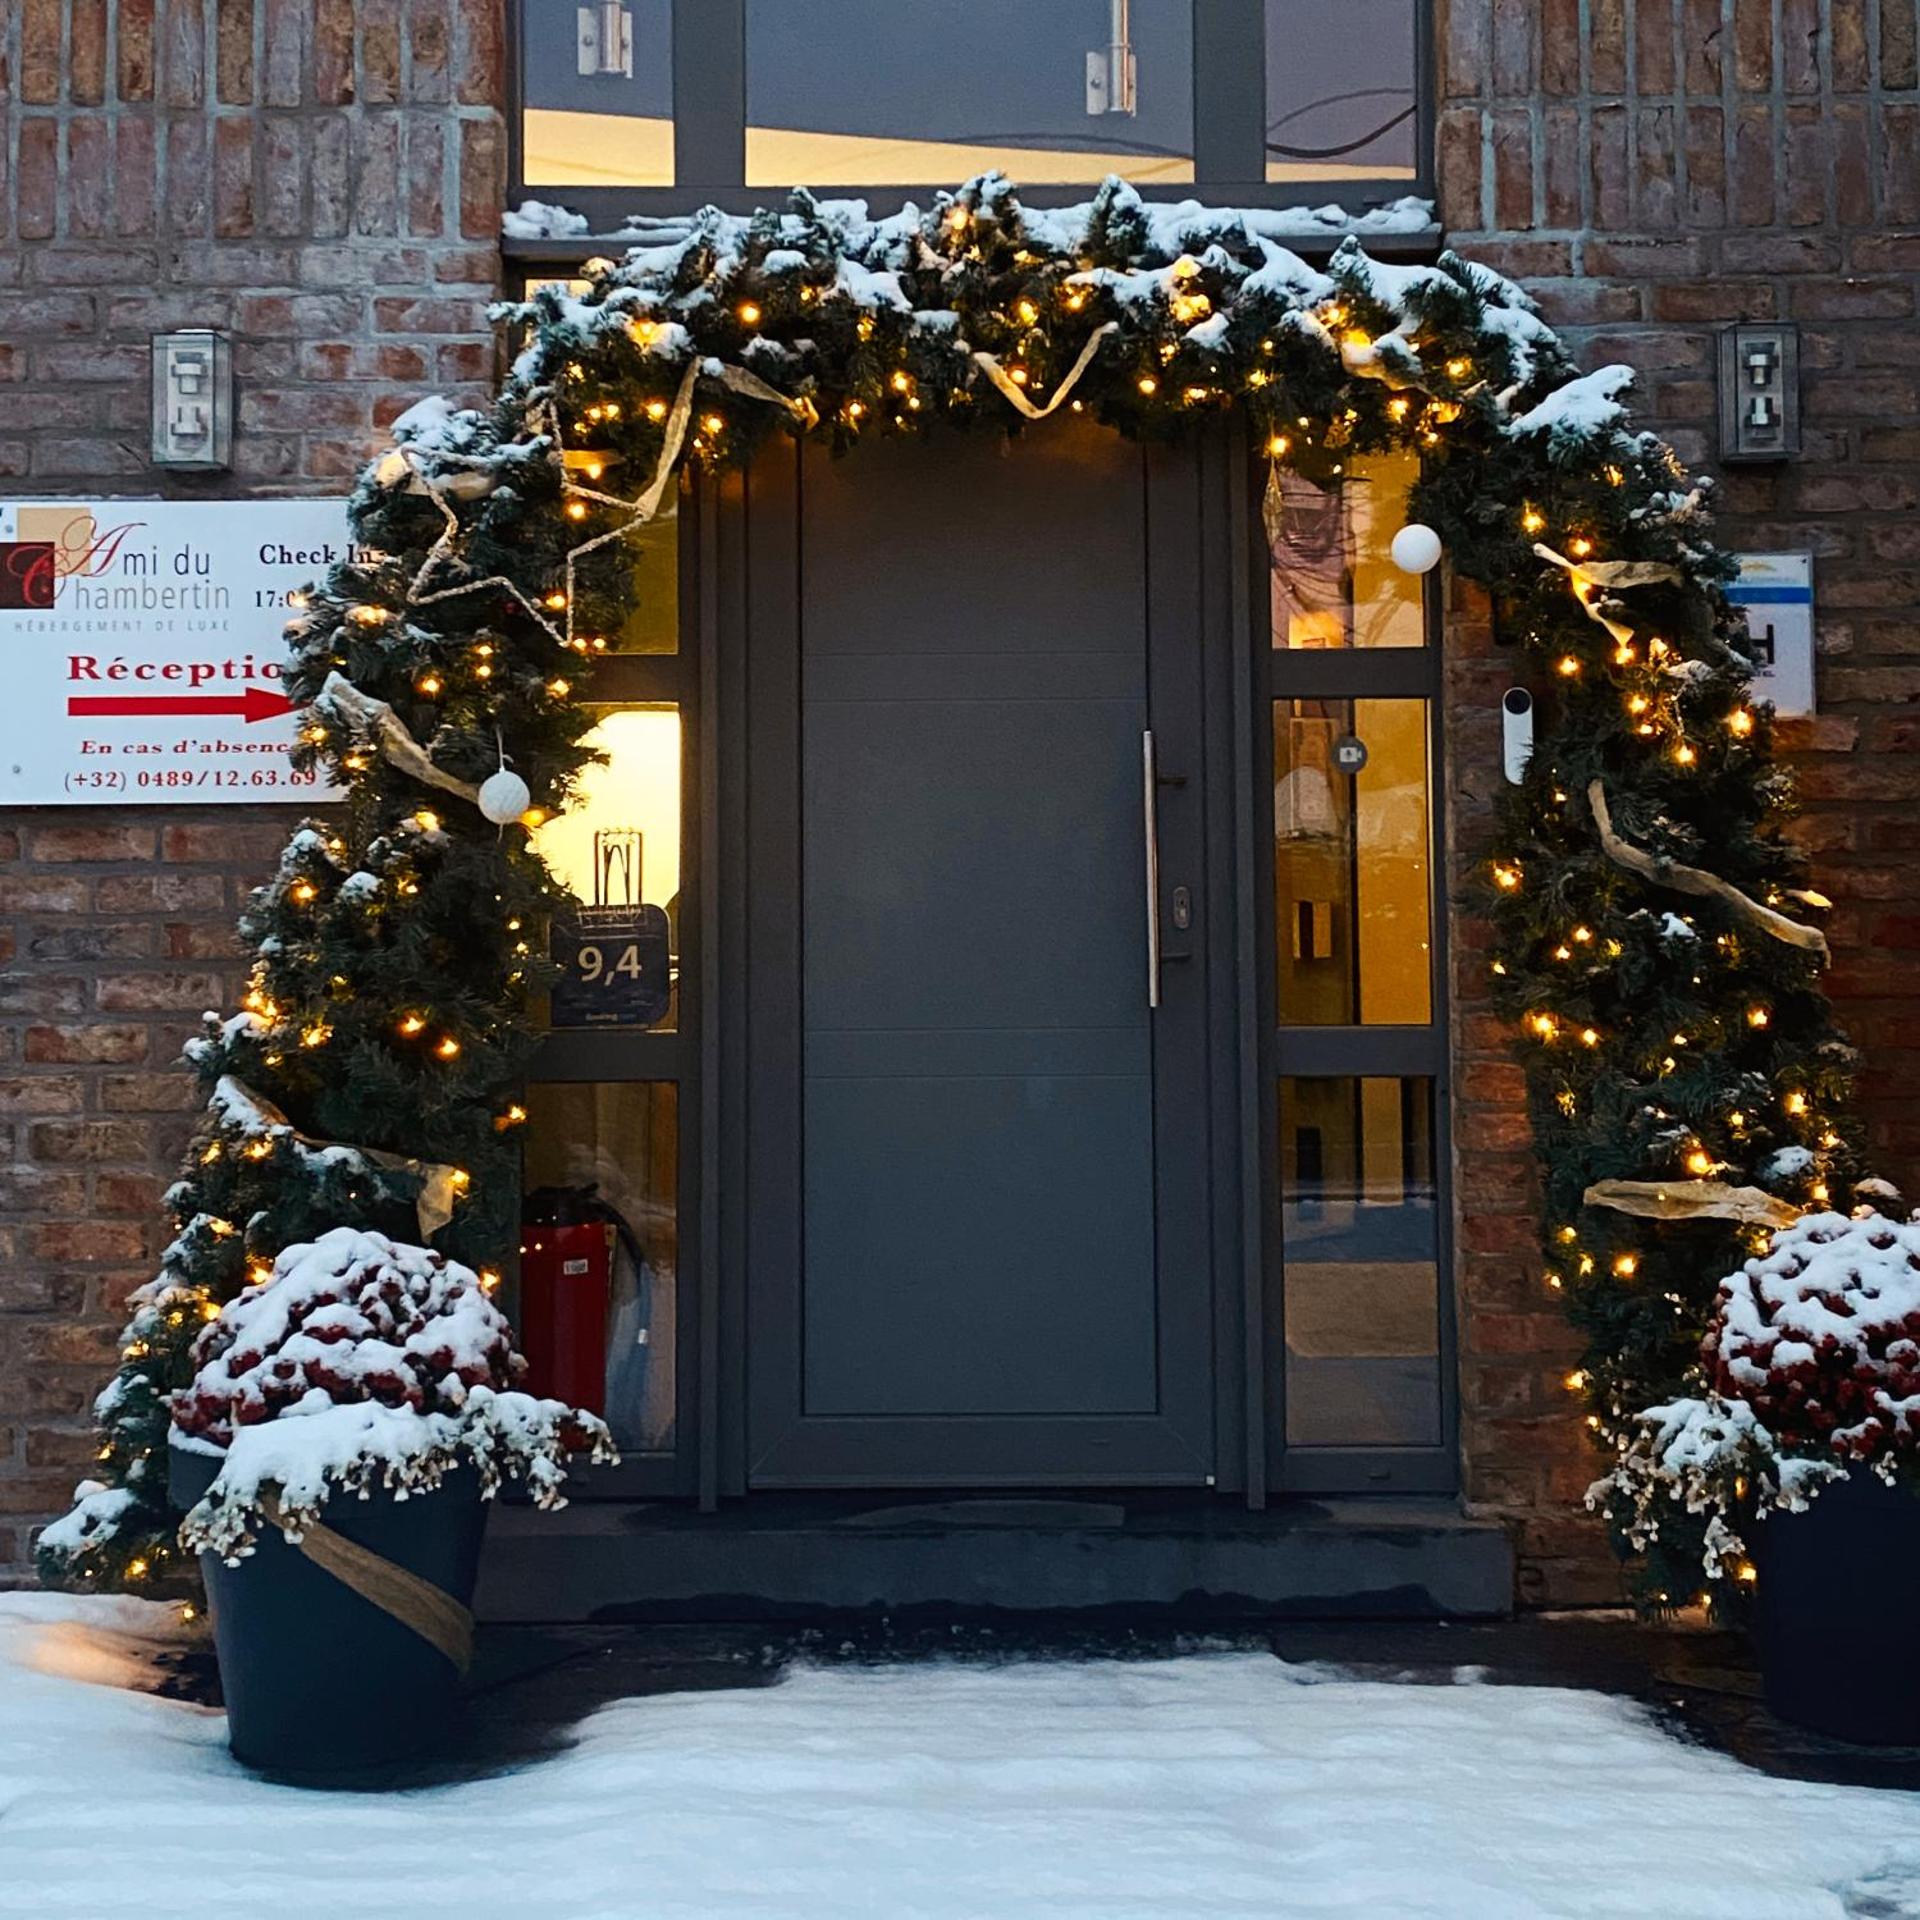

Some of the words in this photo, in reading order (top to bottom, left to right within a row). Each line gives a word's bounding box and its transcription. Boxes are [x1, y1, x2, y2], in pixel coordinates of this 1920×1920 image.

[174, 544, 210, 576] du
[259, 543, 337, 564] Check
[255, 590, 297, 608] 17:0
[14, 618, 142, 632] HÉBERGEMENT
[155, 620, 174, 632] DE
[187, 619, 229, 632] LUXE
[67, 654, 284, 688] Réceptio
[80, 740, 112, 755] En
[122, 743, 163, 755] cas
[173, 739, 289, 755] d'absenc
[64, 771, 127, 793] (+32)
[137, 769, 316, 787] 0489/12.63.69
[577, 944, 643, 987] 9,4
